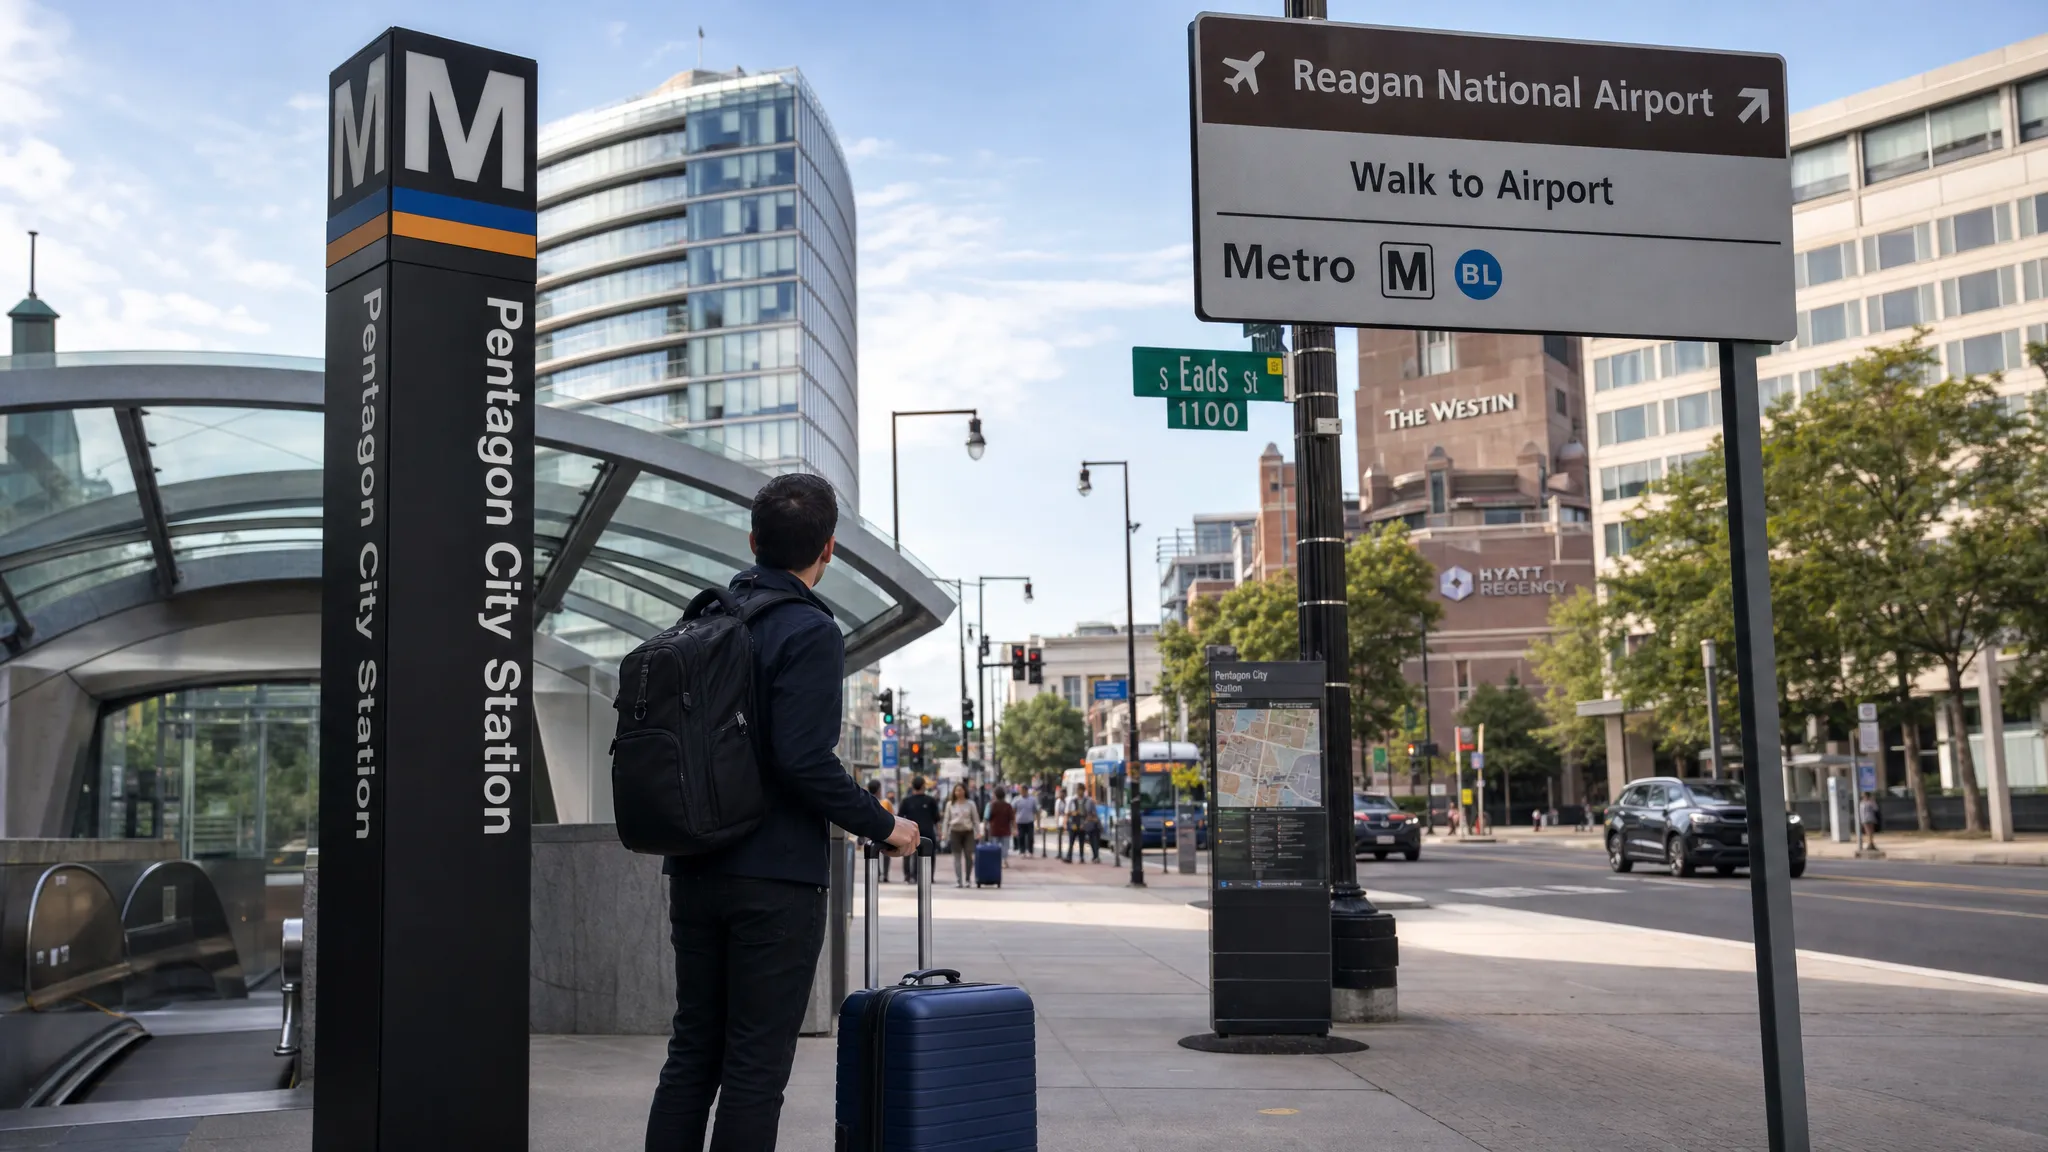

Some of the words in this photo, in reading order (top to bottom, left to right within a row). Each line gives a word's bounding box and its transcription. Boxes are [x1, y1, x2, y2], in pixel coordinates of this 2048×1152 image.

[1294, 59, 1424, 105] Reagan
[1437, 69, 1581, 108] National
[1593, 79, 1714, 122] Airport
[333, 53, 386, 200] M
[405, 51, 525, 192] M
[1350, 161, 1438, 196] Walk
[1448, 168, 1484, 199] to
[1497, 169, 1614, 211] Airport
[1223, 243, 1356, 284] Metro
[1388, 249, 1428, 292] M
[1462, 263, 1498, 286] BL
[1159, 366, 1169, 391] S
[1179, 355, 1229, 393] Eads
[1243, 370, 1258, 394] St
[357, 287, 382, 527] Pentagon
[478, 296, 524, 526] Pentagon
[1179, 400, 1239, 428] 1100
[1384, 408, 1428, 430] THE
[1430, 392, 1516, 422] WESTIN
[356, 541, 379, 640] City
[479, 542, 522, 640] City
[1479, 565, 1544, 581] HYATT
[1480, 579, 1568, 596] REGENCY
[1214, 670, 1251, 682] Pentagon
[1252, 669, 1268, 682] City
[1215, 683, 1243, 693] Station
[357, 659, 377, 839] Station
[484, 658, 522, 834] Station
